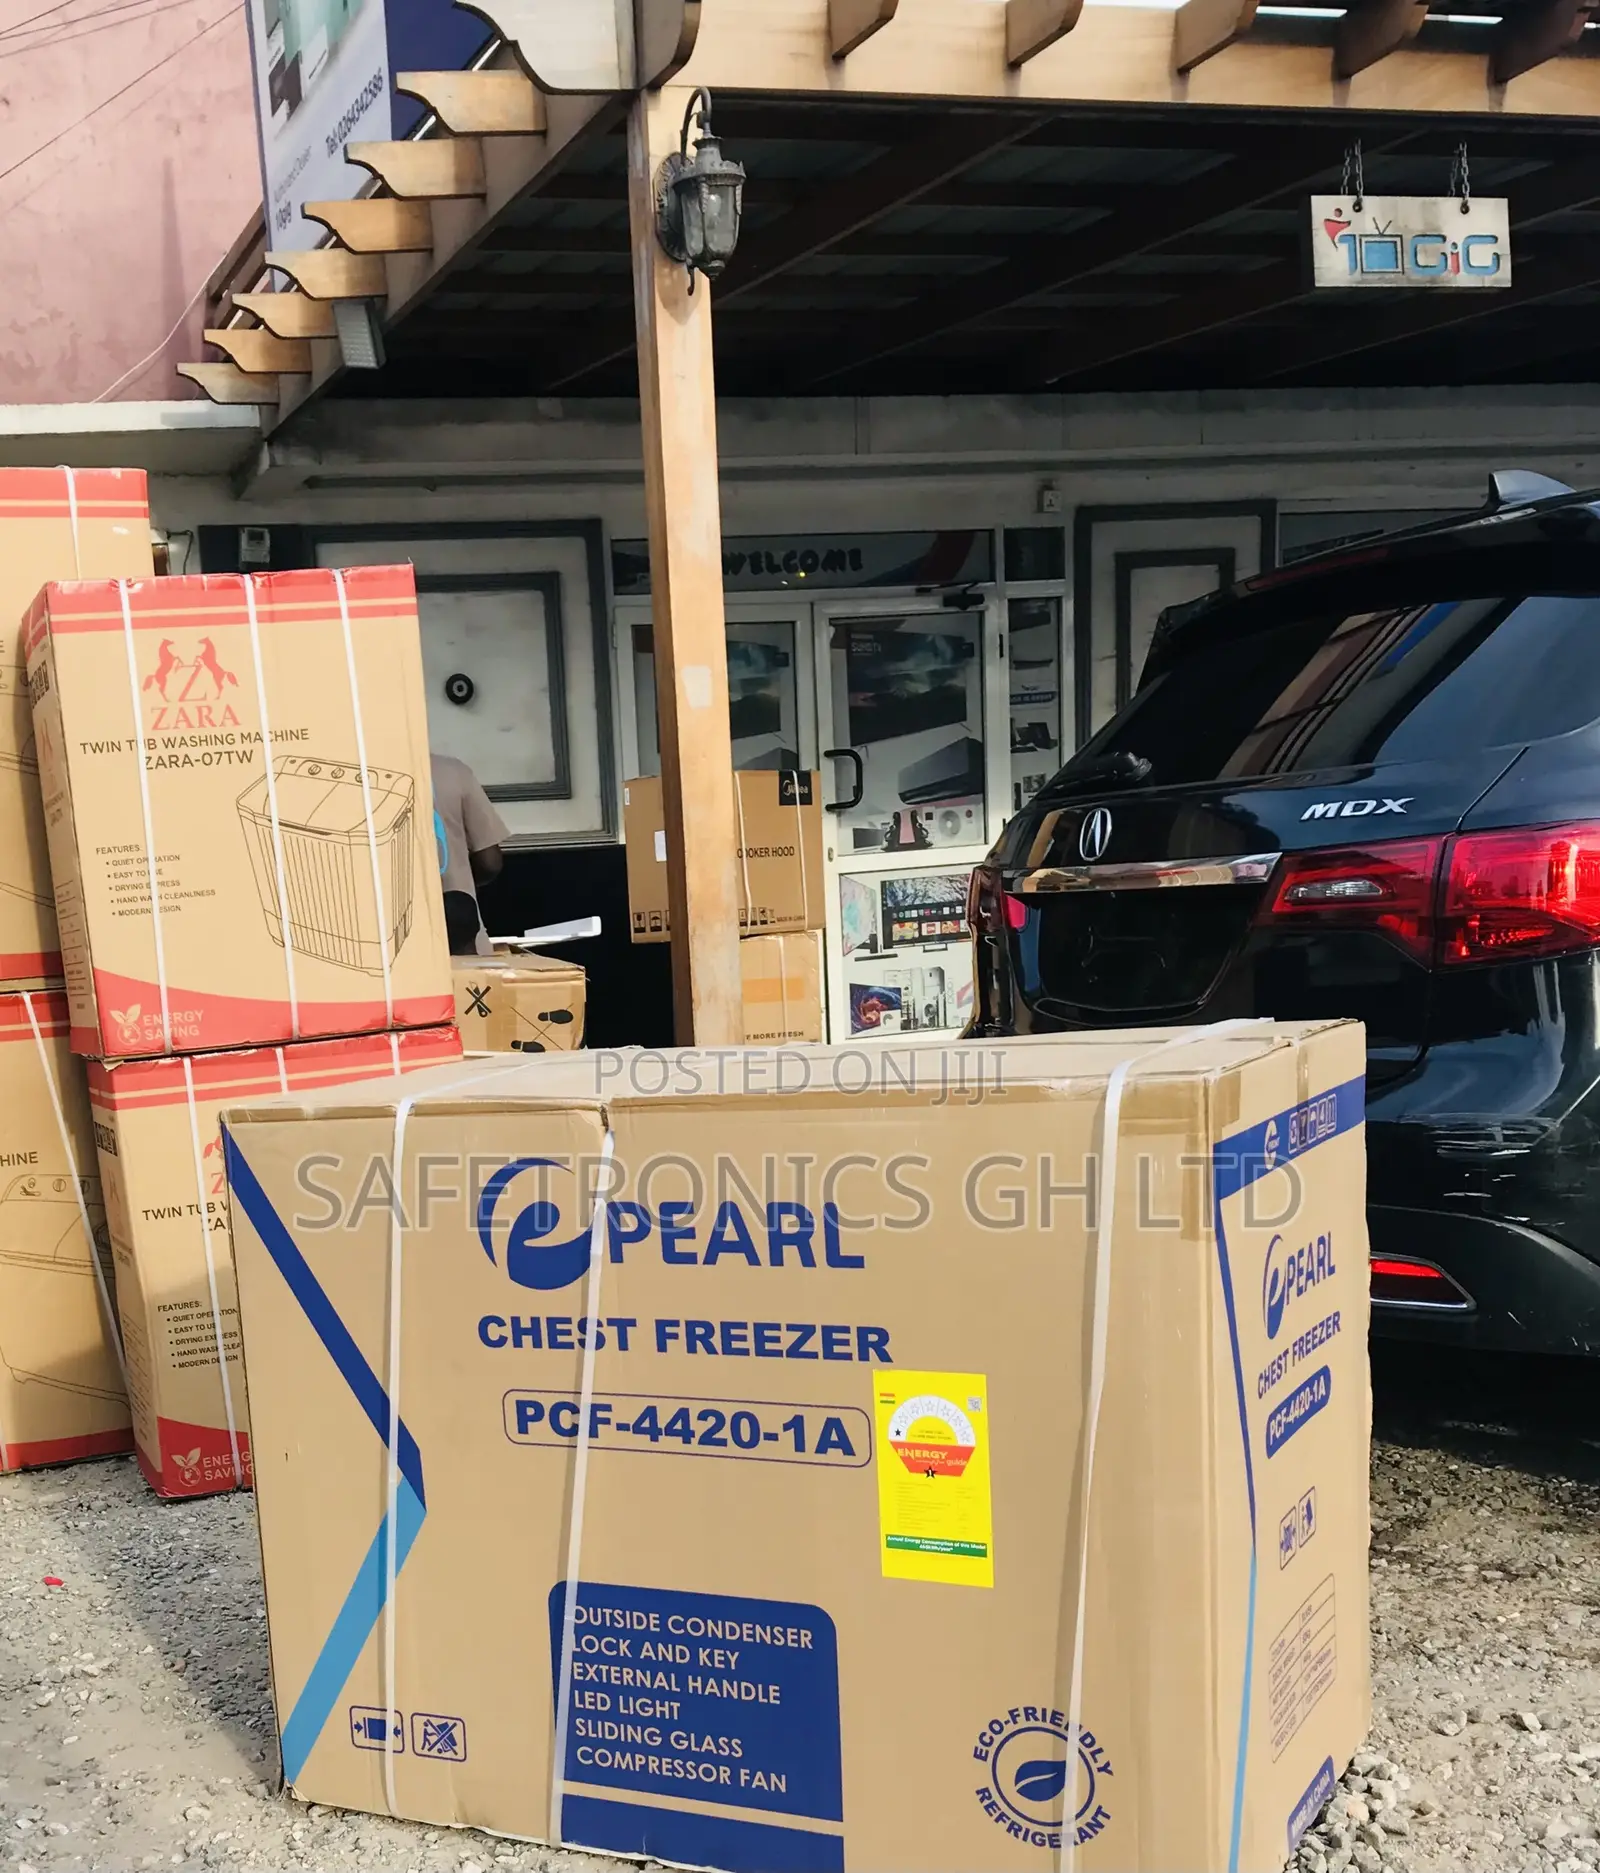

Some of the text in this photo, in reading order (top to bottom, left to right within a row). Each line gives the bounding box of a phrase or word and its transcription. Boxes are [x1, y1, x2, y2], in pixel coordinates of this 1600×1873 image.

[151, 704, 242, 731] ZARA
[80, 740, 121, 755] TWIN
[162, 733, 236, 750] WASHING
[145, 749, 254, 770] ZARA-07TW
[1300, 797, 1416, 821] MDX
[772, 846, 795, 857] HOOD
[112, 858, 135, 867] QUIET
[113, 871, 134, 880] EASY
[136, 869, 147, 877] TO
[115, 880, 181, 892] DRYING EPRESS
[116, 896, 139, 905] HAND
[164, 889, 216, 901] CLEANLINESS
[118, 904, 182, 917] MODERN ESIGN
[753, 1032, 776, 1040] MORE
[142, 1206, 182, 1221] TWIN
[607, 1200, 865, 1269] PEARL
[1286, 1231, 1336, 1306] PEARL
[172, 1314, 195, 1323] QUIET
[174, 1326, 193, 1335] EASY
[195, 1324, 206, 1332] TO
[477, 1315, 894, 1364] CHEST FREEZER
[175, 1337, 203, 1346] DRYING
[177, 1348, 198, 1358] HAND
[1257, 1311, 1341, 1400] CHEST FREEZER
[178, 1359, 210, 1369] MODERN
[1269, 1375, 1326, 1446] PCF-4420-1A
[515, 1399, 857, 1457] PCF-4420-1A
[898, 1448, 948, 1460] ENERGY
[573, 1605, 813, 1650] OUTSIDE CONDENSER
[572, 1634, 740, 1670] LOCK AND KEY
[573, 1662, 781, 1705] EXTERNAL HANDLE
[574, 1690, 680, 1720] LED LIGHT
[575, 1718, 743, 1758] SLIDING GLASS
[576, 1746, 787, 1793] COMPRESSOR FAN
